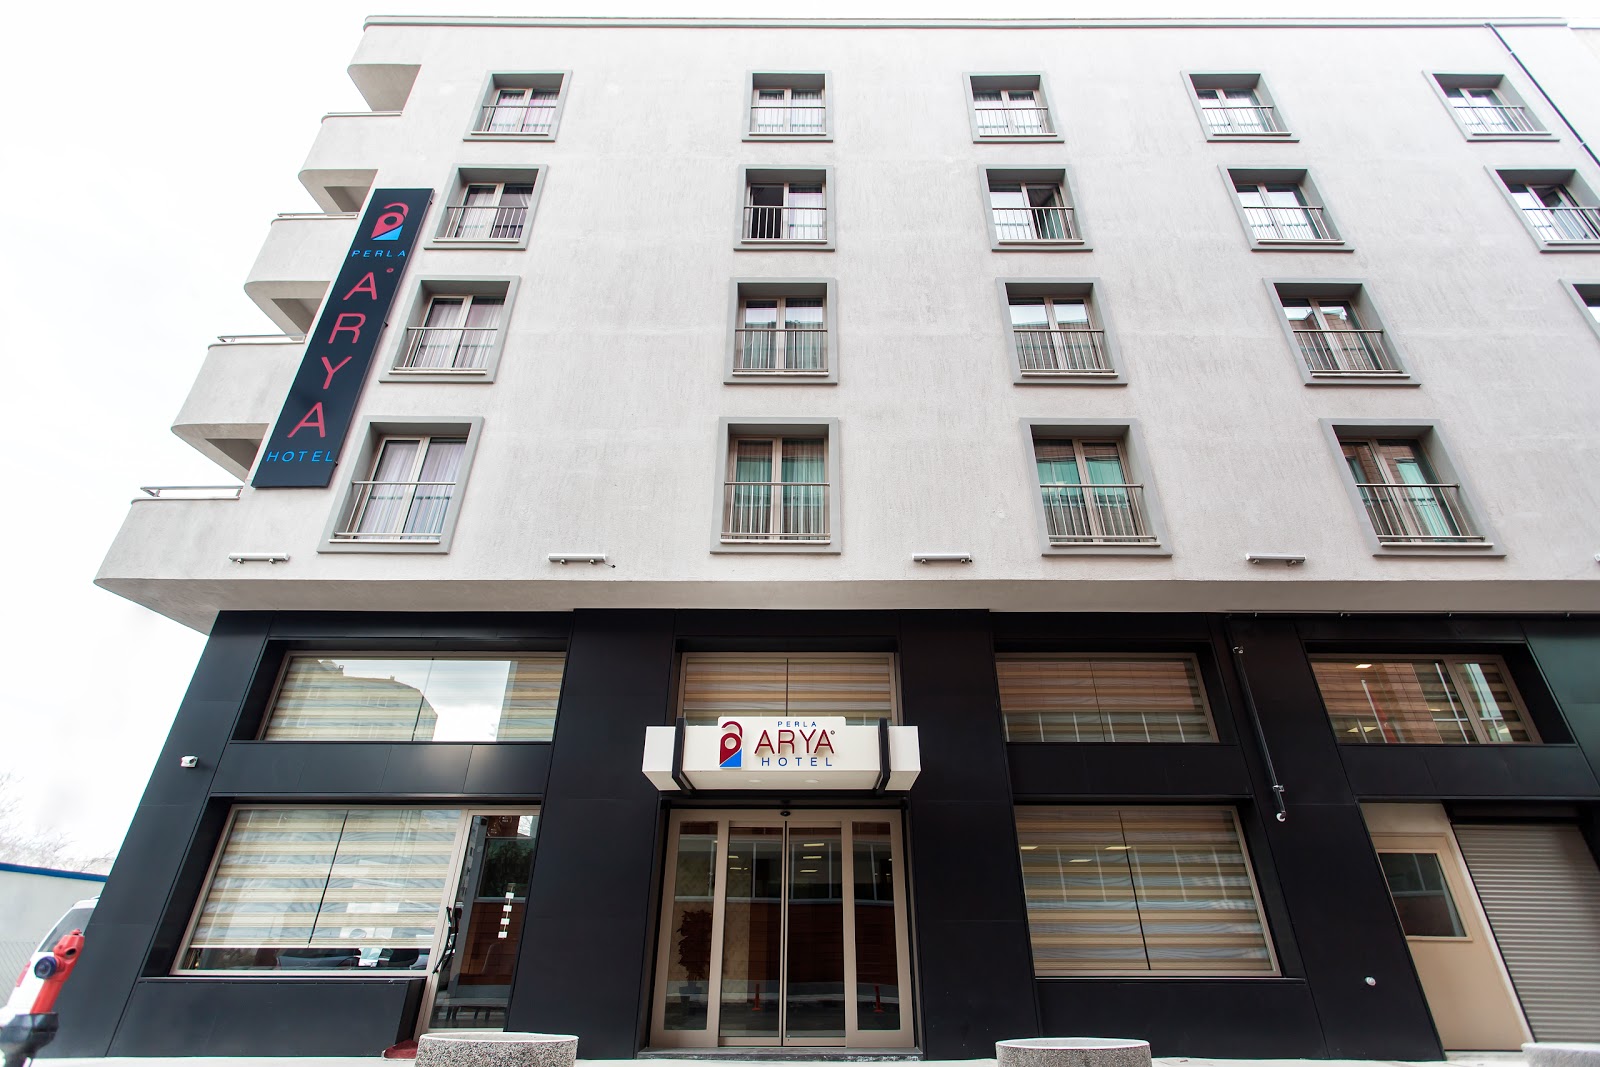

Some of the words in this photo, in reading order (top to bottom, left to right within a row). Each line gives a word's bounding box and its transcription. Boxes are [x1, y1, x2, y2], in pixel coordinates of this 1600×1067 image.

[351, 249, 406, 258] PERLA
[266, 450, 334, 463] HOTEL
[761, 757, 832, 767] HOTEL
